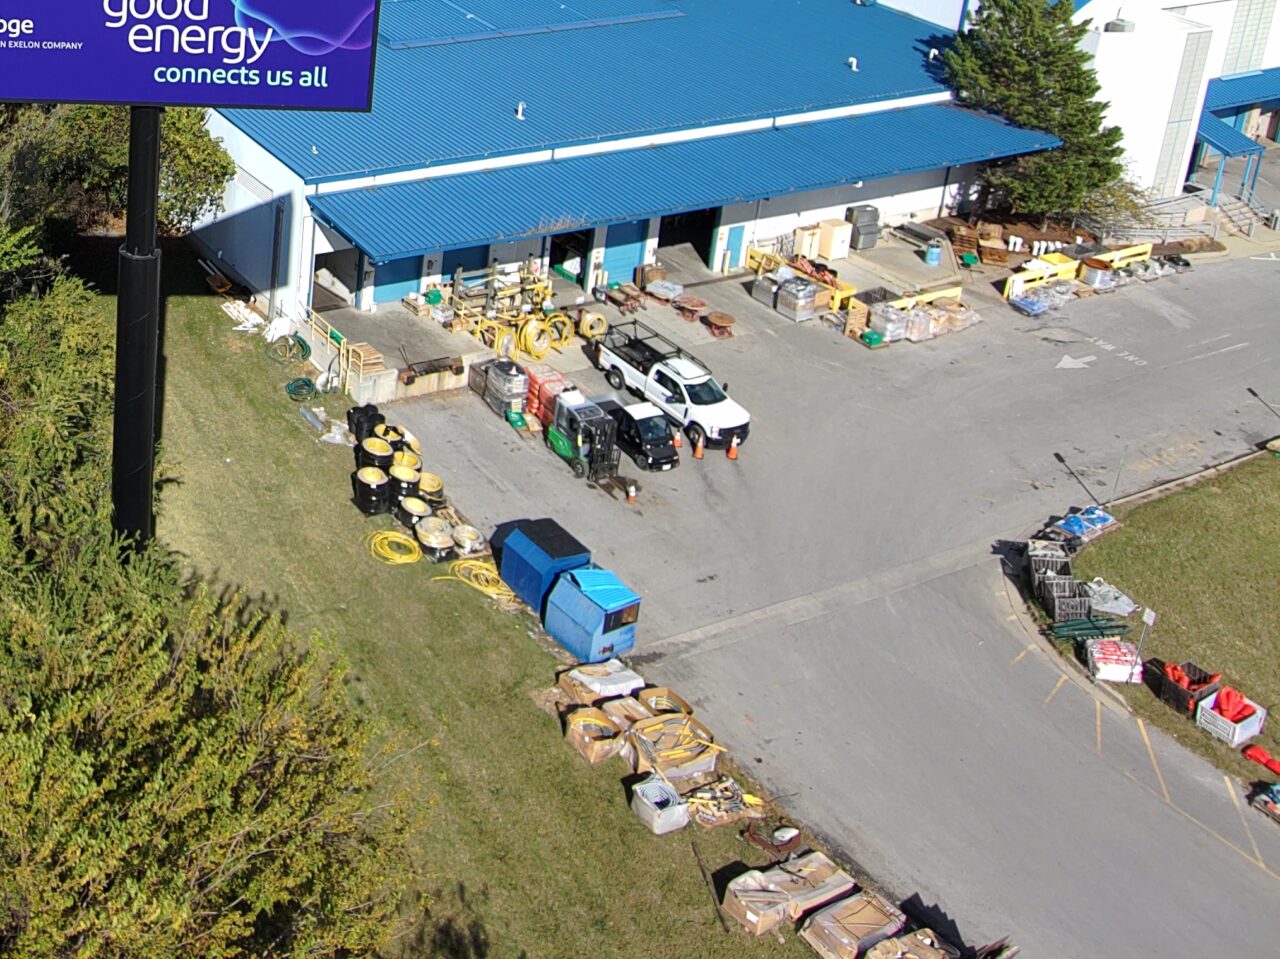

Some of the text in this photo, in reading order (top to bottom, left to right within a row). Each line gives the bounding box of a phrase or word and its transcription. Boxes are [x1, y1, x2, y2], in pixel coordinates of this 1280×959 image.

[8, 41, 40, 49] EXELON
[42, 41, 83, 50] COMPANY
[128, 22, 274, 64] energy
[153, 66, 329, 88] connects us all
[1084, 336, 1148, 366] ONE WAY
